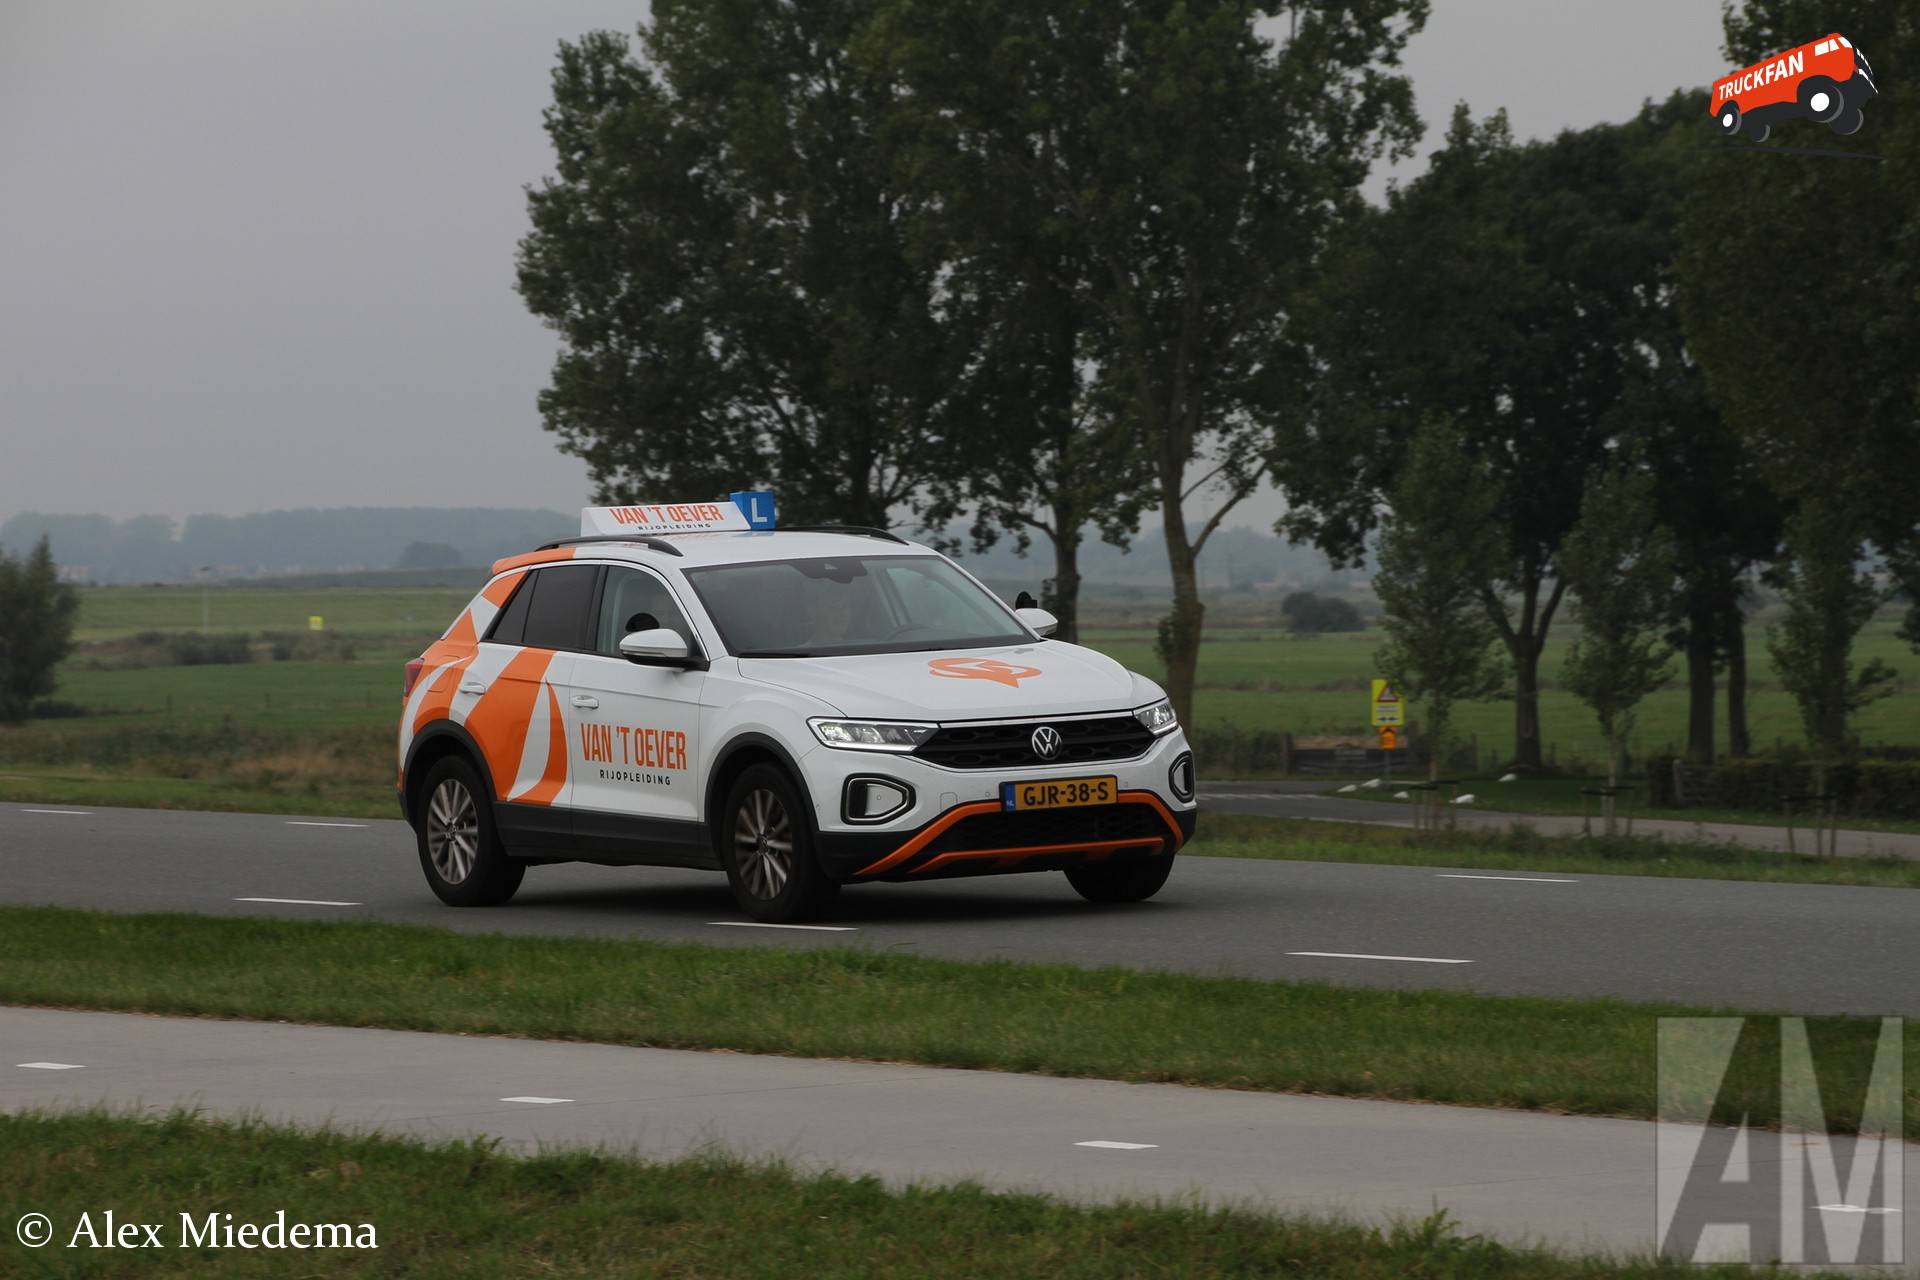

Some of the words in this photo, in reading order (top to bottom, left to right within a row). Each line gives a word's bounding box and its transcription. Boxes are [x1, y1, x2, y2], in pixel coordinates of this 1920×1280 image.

[609, 508, 648, 524] VAN
[668, 504, 725, 521] OEVER
[751, 497, 768, 522] L
[580, 722, 612, 763] VAN
[634, 727, 687, 770] OEVER
[600, 769, 671, 785] RIJOPLEIDING
[1023, 781, 1109, 806] GJR-38-S
